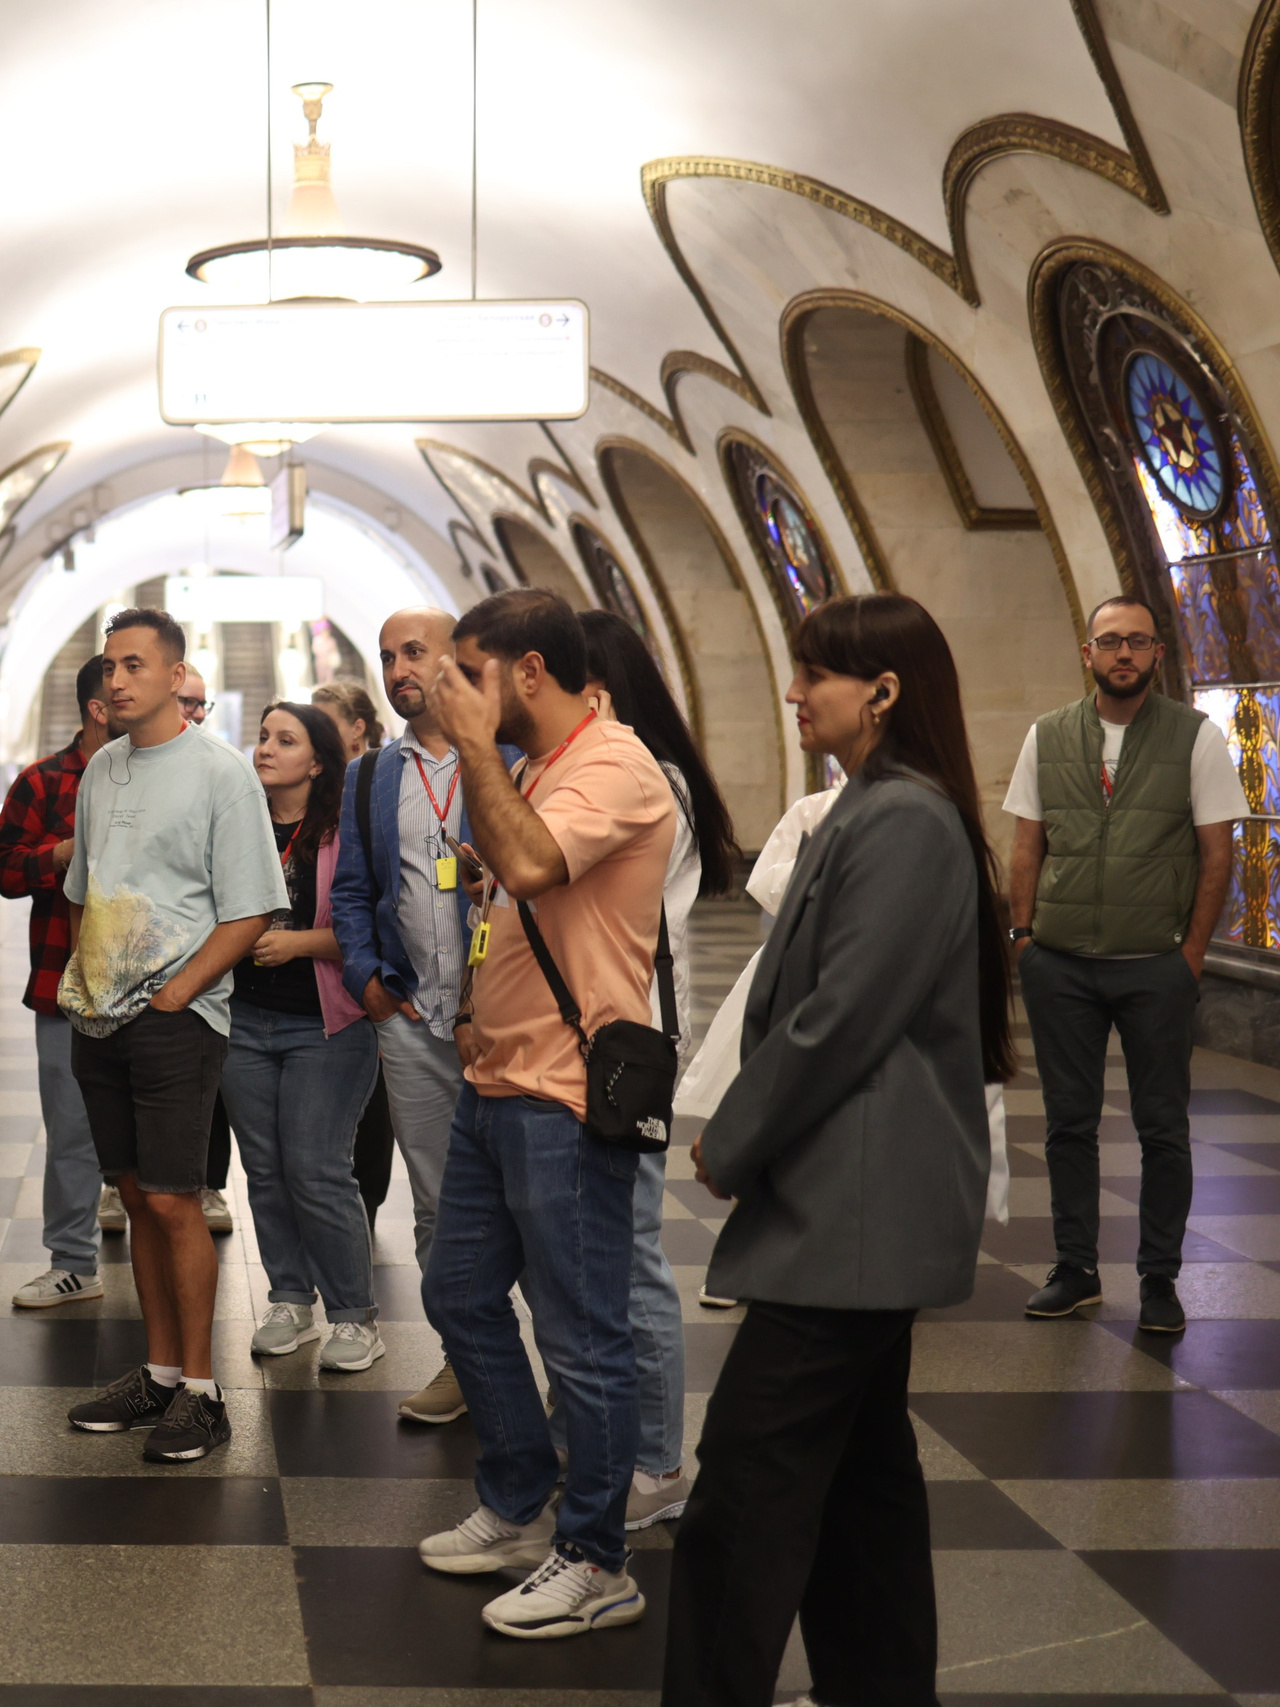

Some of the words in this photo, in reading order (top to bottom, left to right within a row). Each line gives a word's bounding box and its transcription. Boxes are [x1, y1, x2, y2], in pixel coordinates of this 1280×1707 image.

[636, 1120, 659, 1133] NORTH
[647, 1116, 660, 1126] THE
[641, 1128, 658, 1139] FACE
